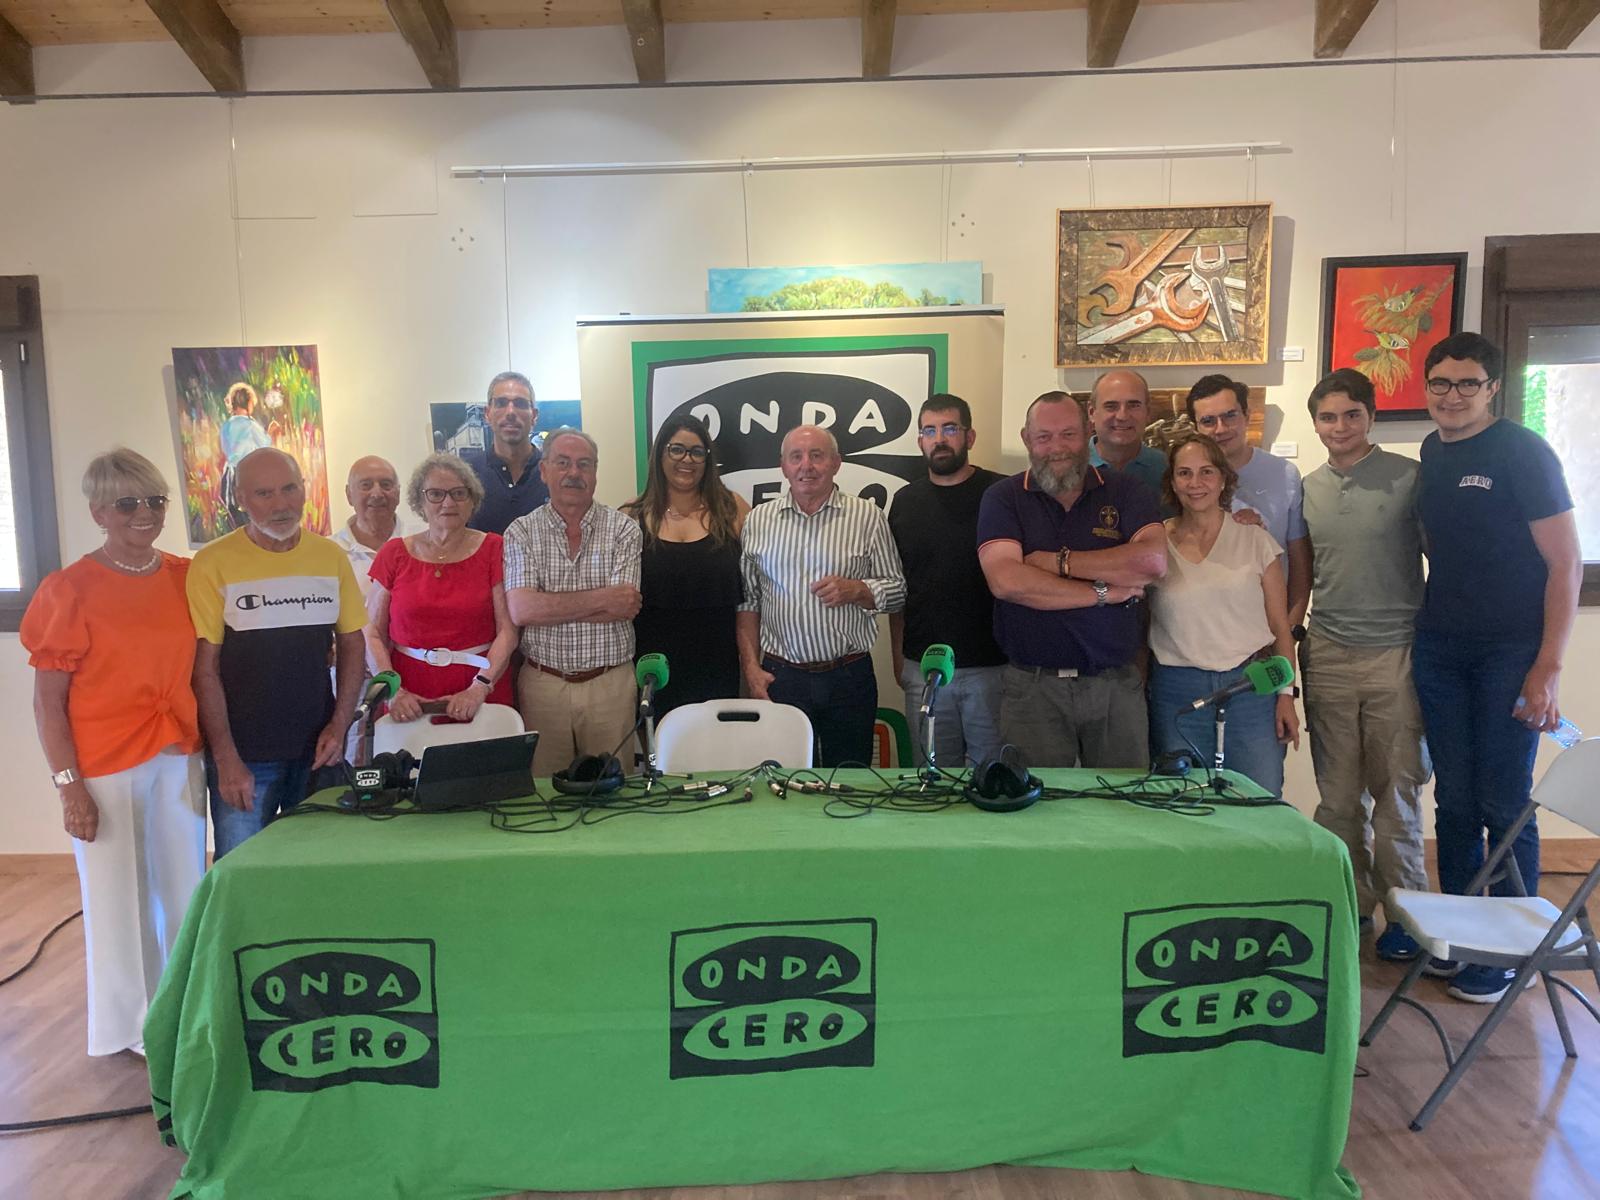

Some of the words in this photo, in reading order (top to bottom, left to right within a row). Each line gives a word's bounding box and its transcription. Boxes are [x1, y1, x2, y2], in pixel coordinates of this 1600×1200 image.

[235, 593, 334, 611] Champion
[1152, 932, 1294, 968] ONDA
[265, 971, 404, 1005] ONDA
[700, 954, 843, 989] ONDA
[1160, 989, 1293, 1027] CERO
[278, 1026, 407, 1067] CERO
[707, 1011, 844, 1049] CERO
